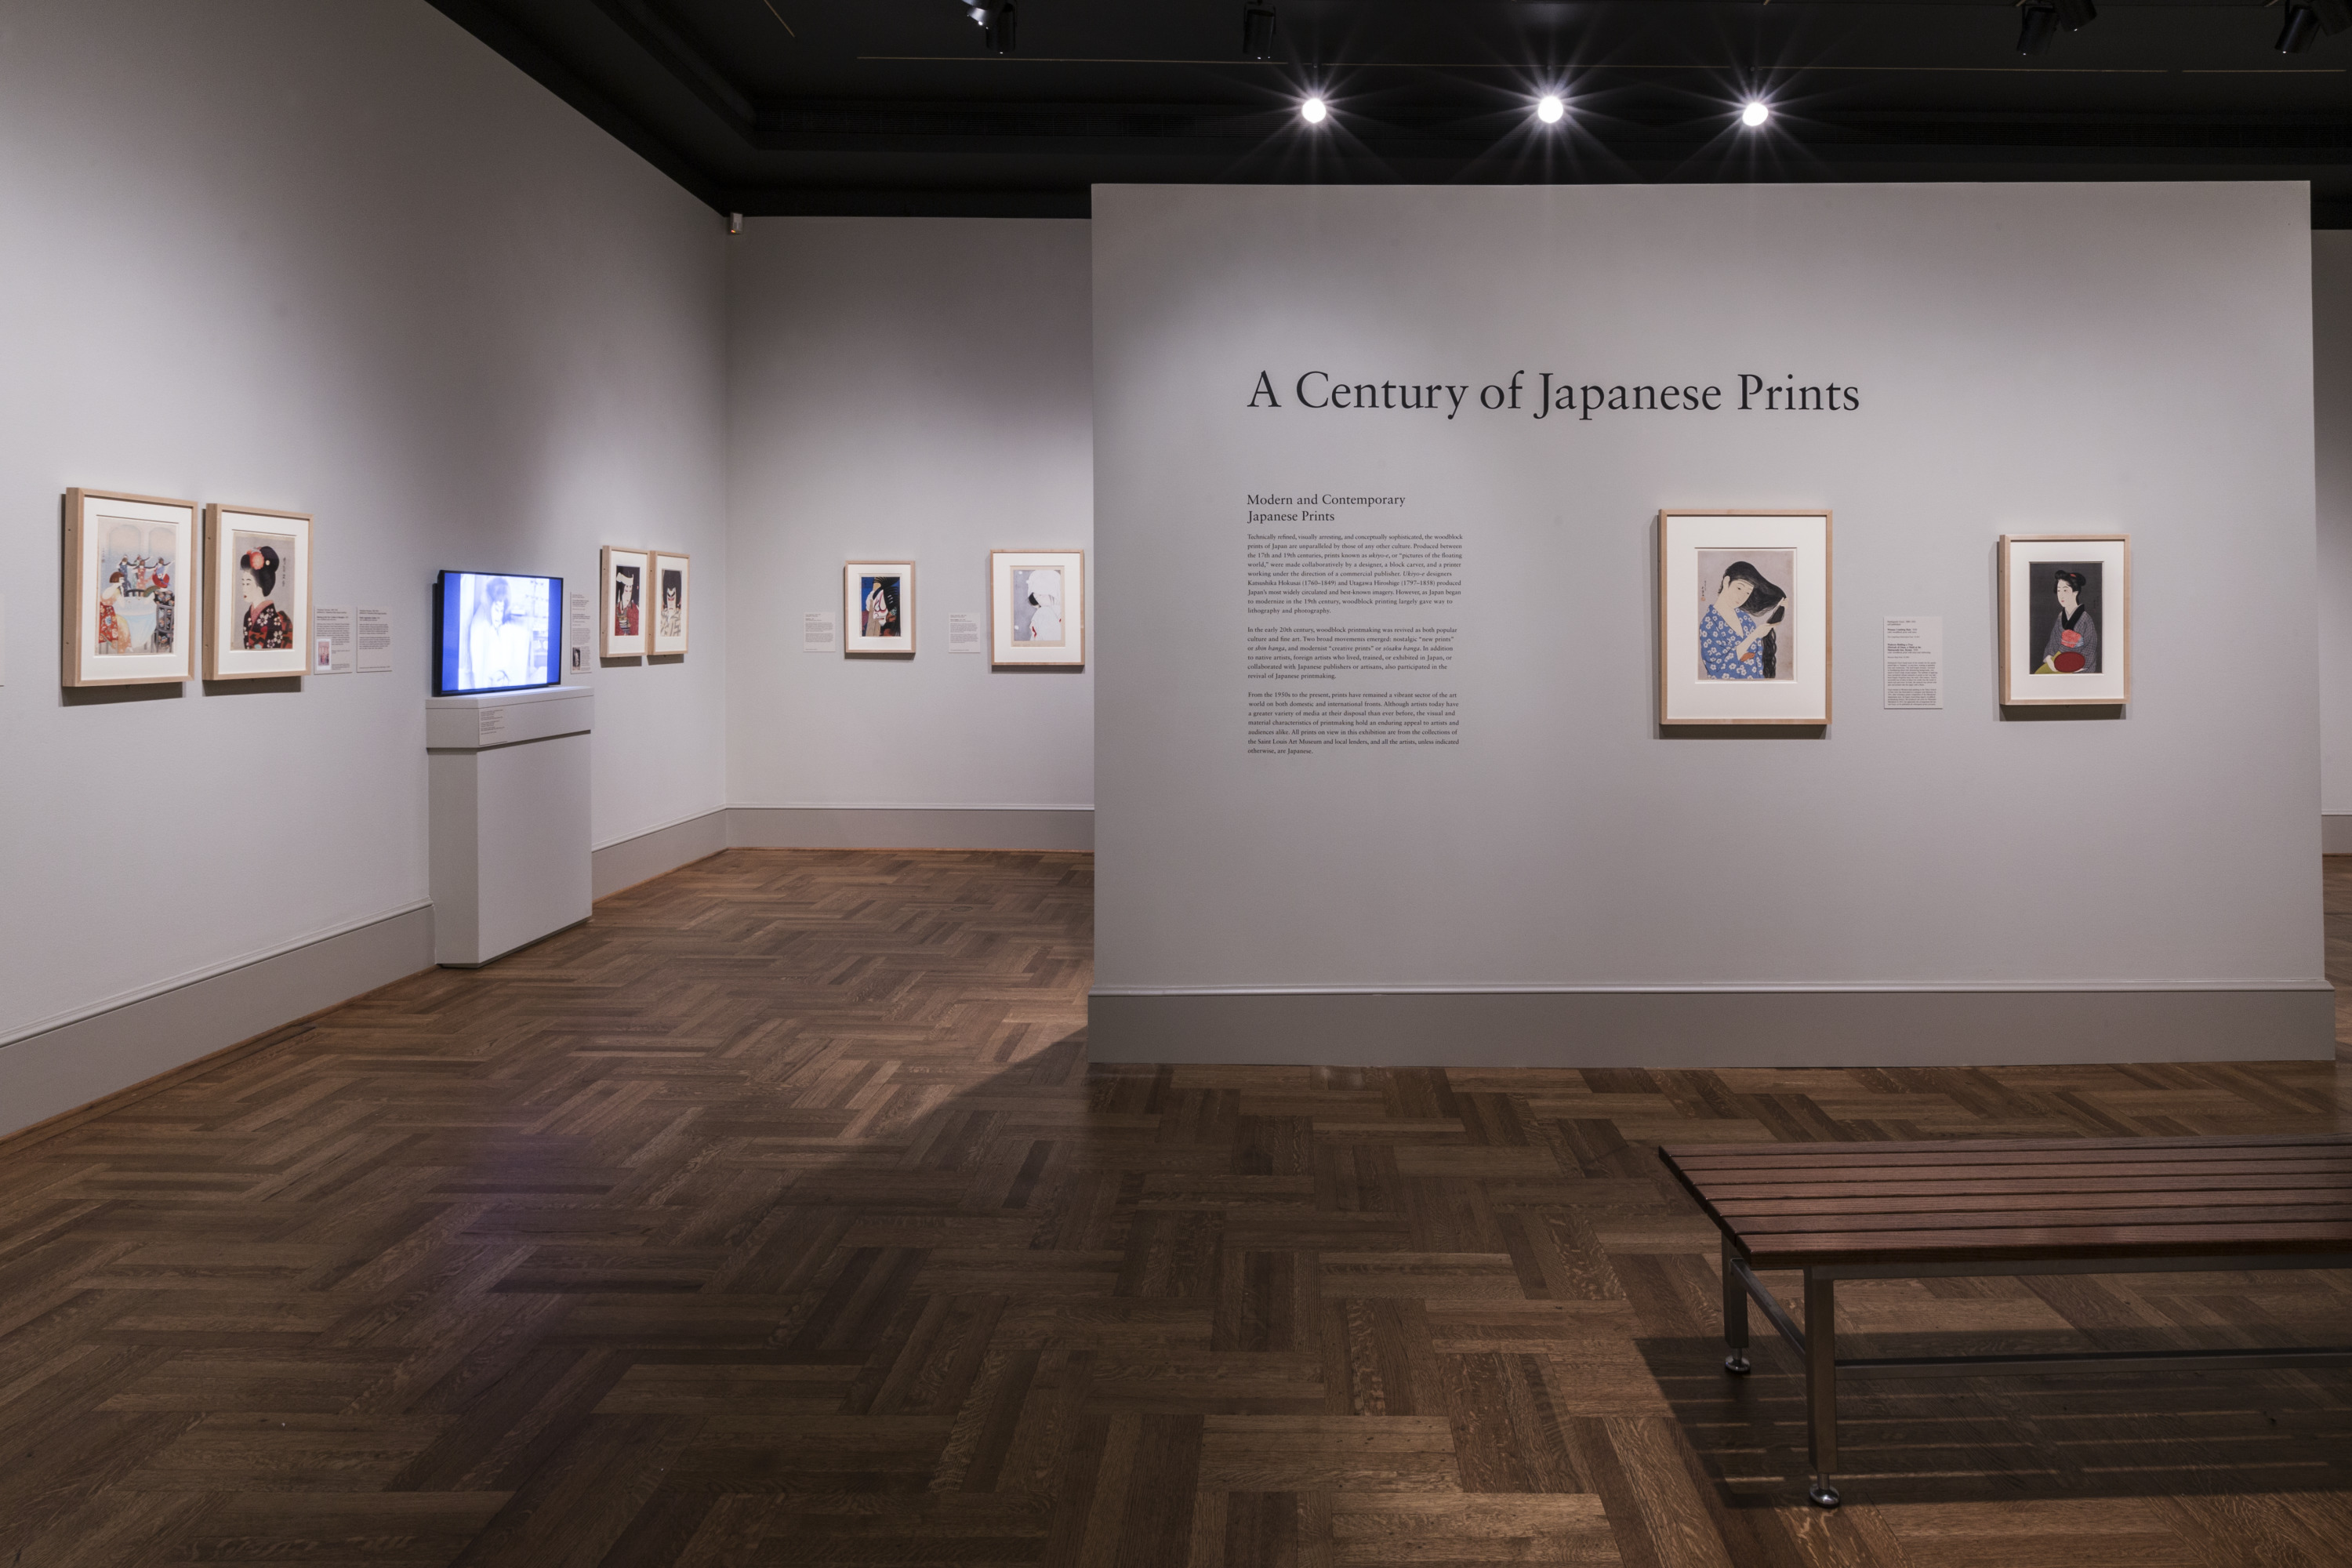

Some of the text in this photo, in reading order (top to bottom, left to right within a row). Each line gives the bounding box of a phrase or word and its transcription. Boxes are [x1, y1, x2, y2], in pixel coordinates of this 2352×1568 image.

[1246, 369, 1860, 421] A Century of Japanese Prints
[1247, 493, 1406, 507] Modern and Contemporary
[1247, 510, 1335, 524] Japanese Prints
